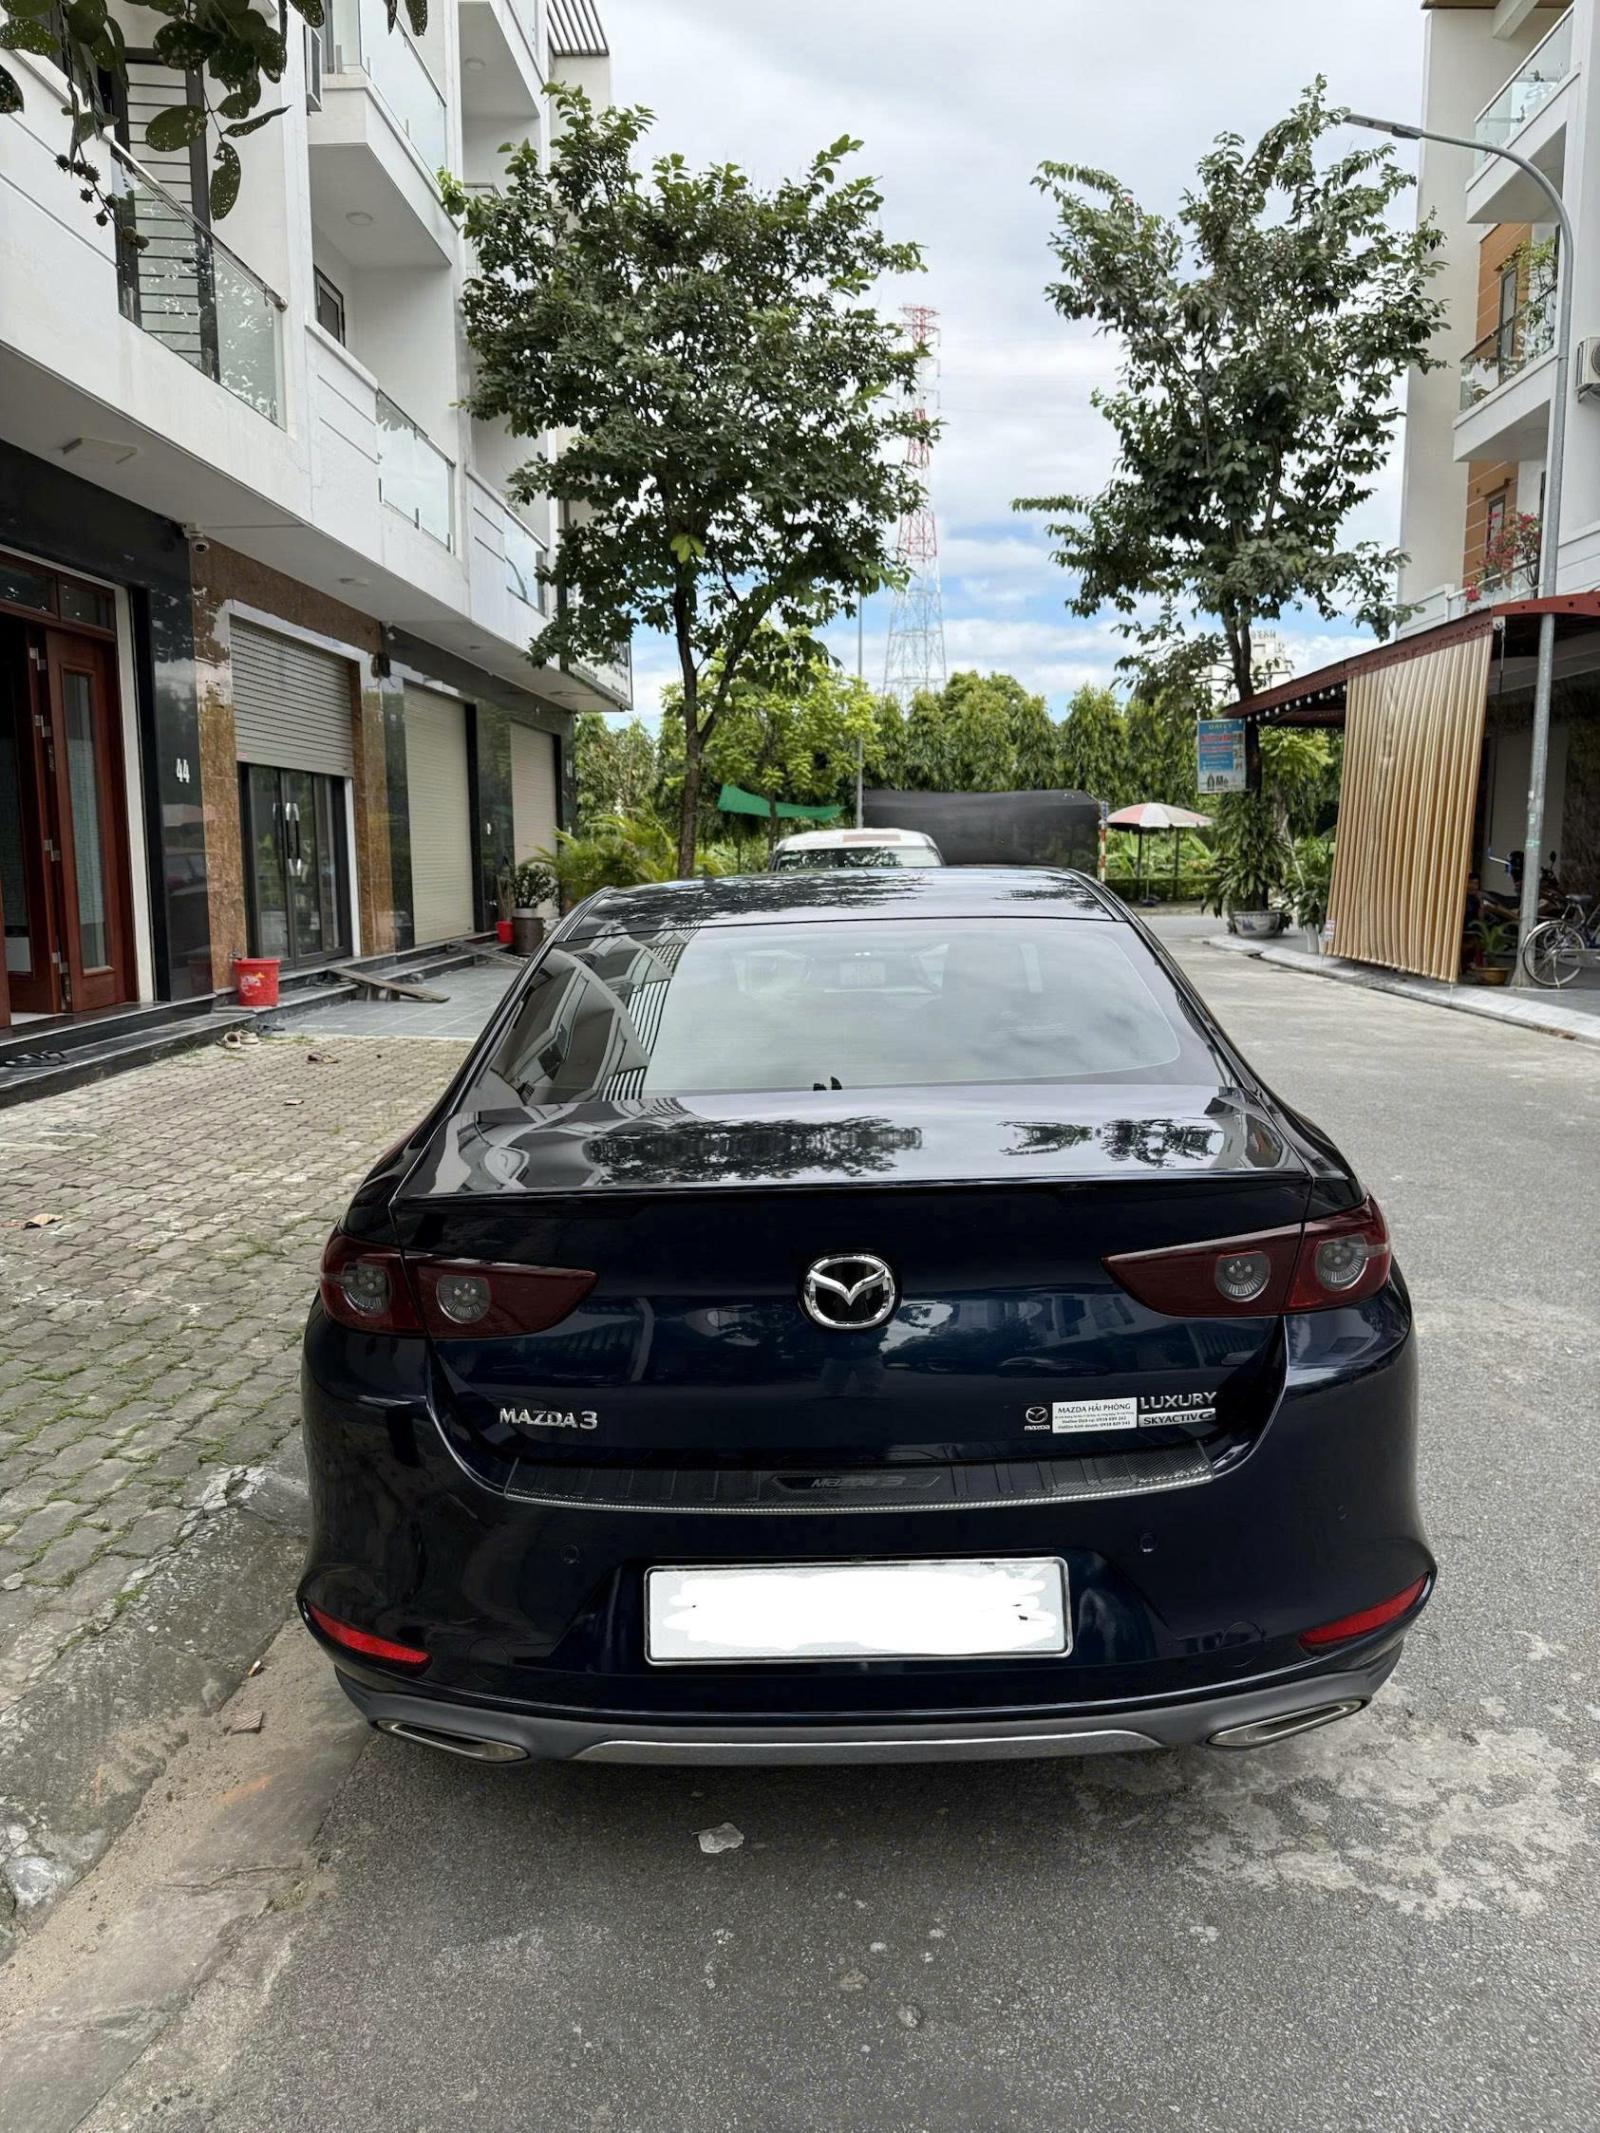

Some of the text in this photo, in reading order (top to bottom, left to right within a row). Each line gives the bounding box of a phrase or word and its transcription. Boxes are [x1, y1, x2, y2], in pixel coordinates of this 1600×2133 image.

[176, 758, 190, 783] 44
[1103, 1402, 1131, 1411] PHÒNG
[1140, 1391, 1217, 1409] LUXURY
